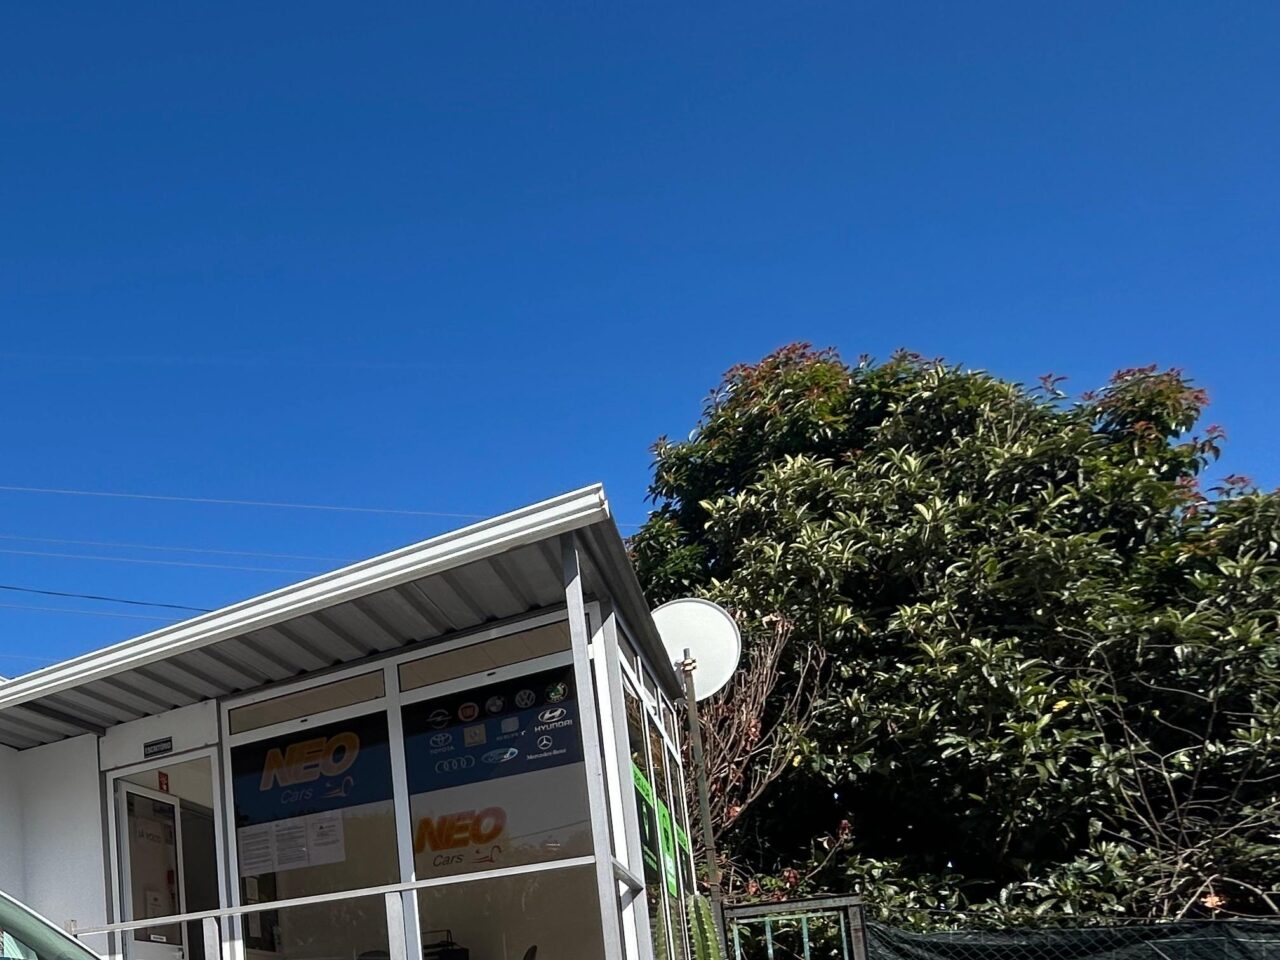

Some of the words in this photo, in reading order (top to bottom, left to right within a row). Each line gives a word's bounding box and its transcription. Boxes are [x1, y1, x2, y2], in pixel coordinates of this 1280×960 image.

[534, 719, 573, 733] HYUNDAI
[259, 731, 361, 792] NEO
[281, 788, 314, 804] Cars
[414, 806, 507, 854] NEO
[432, 854, 464, 867] Cars
